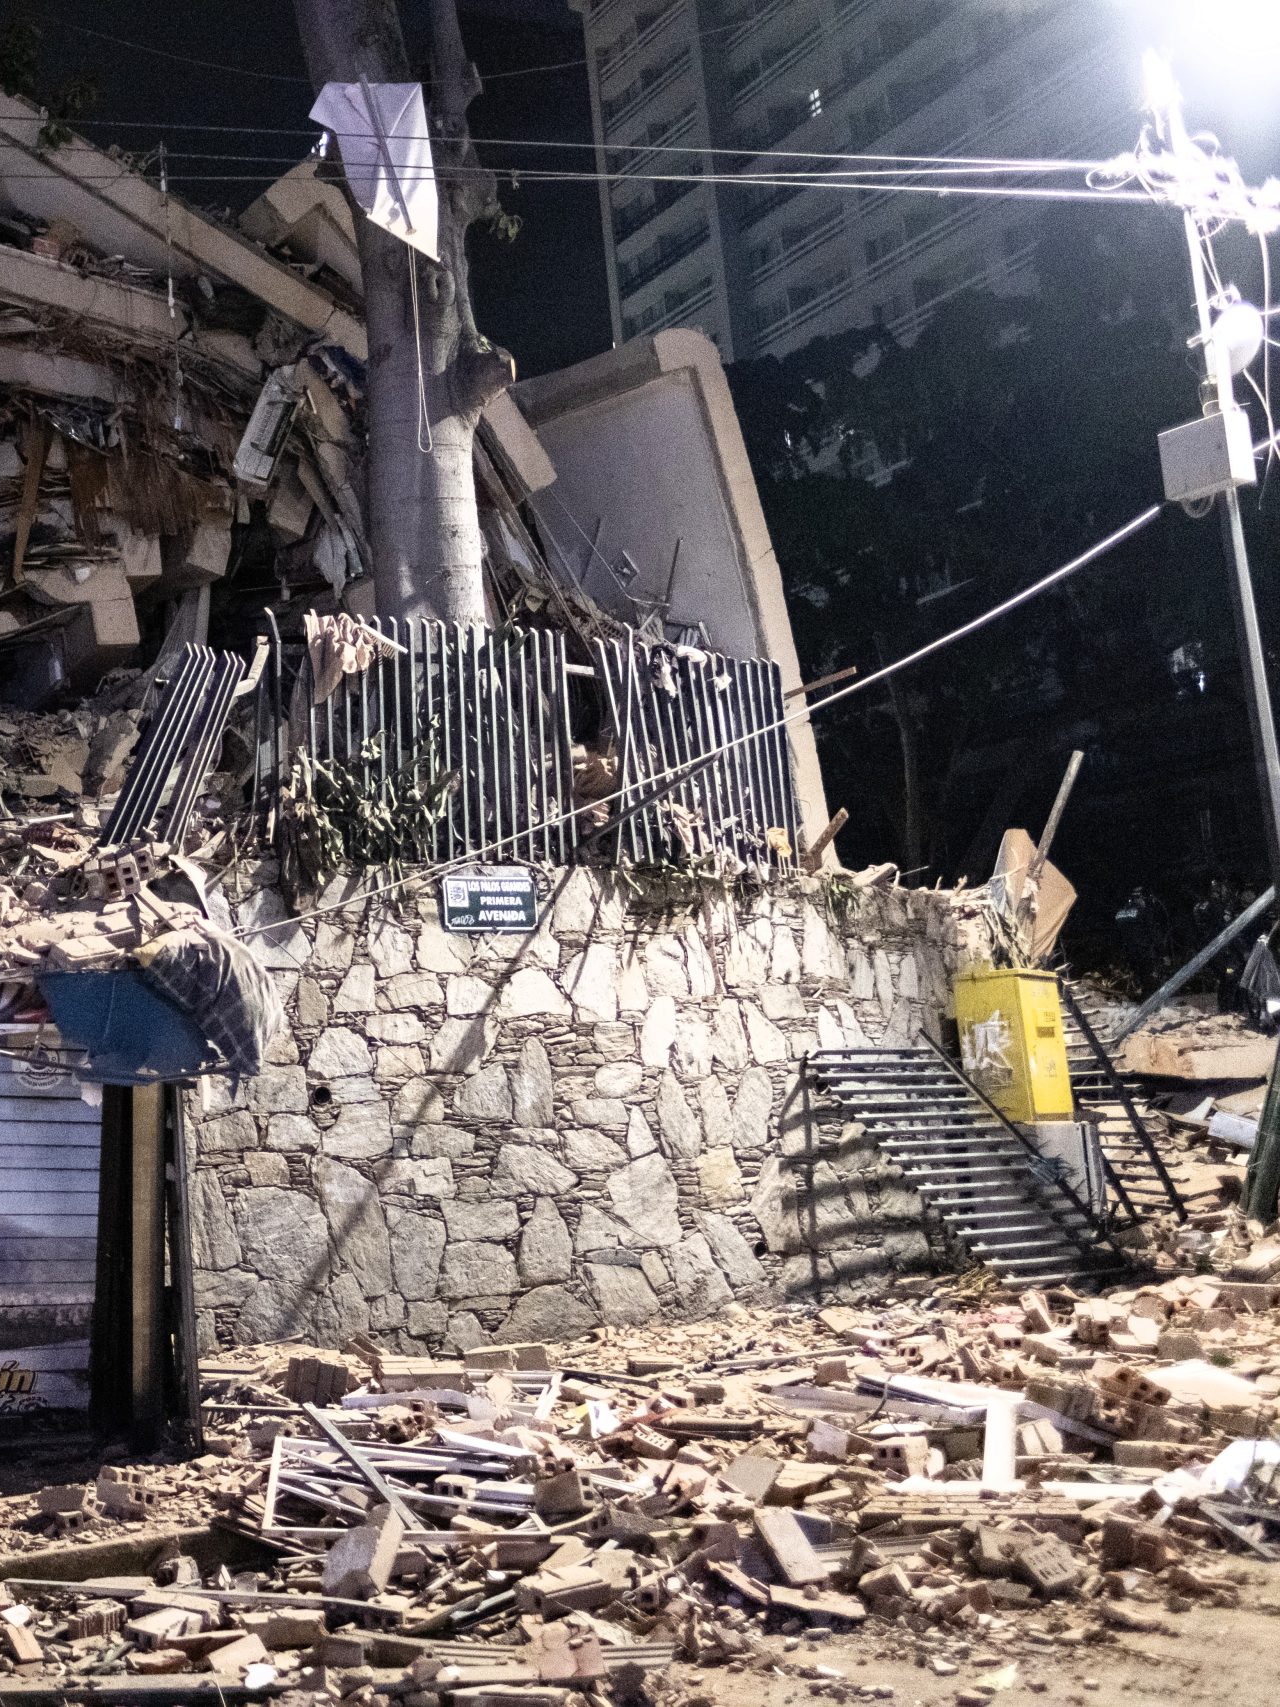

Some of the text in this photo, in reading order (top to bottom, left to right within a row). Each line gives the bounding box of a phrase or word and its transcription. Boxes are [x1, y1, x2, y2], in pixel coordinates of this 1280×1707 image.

[468, 881, 480, 892] LOS
[480, 896, 522, 905] PRIMERA
[478, 910, 526, 921] AVENIDA
